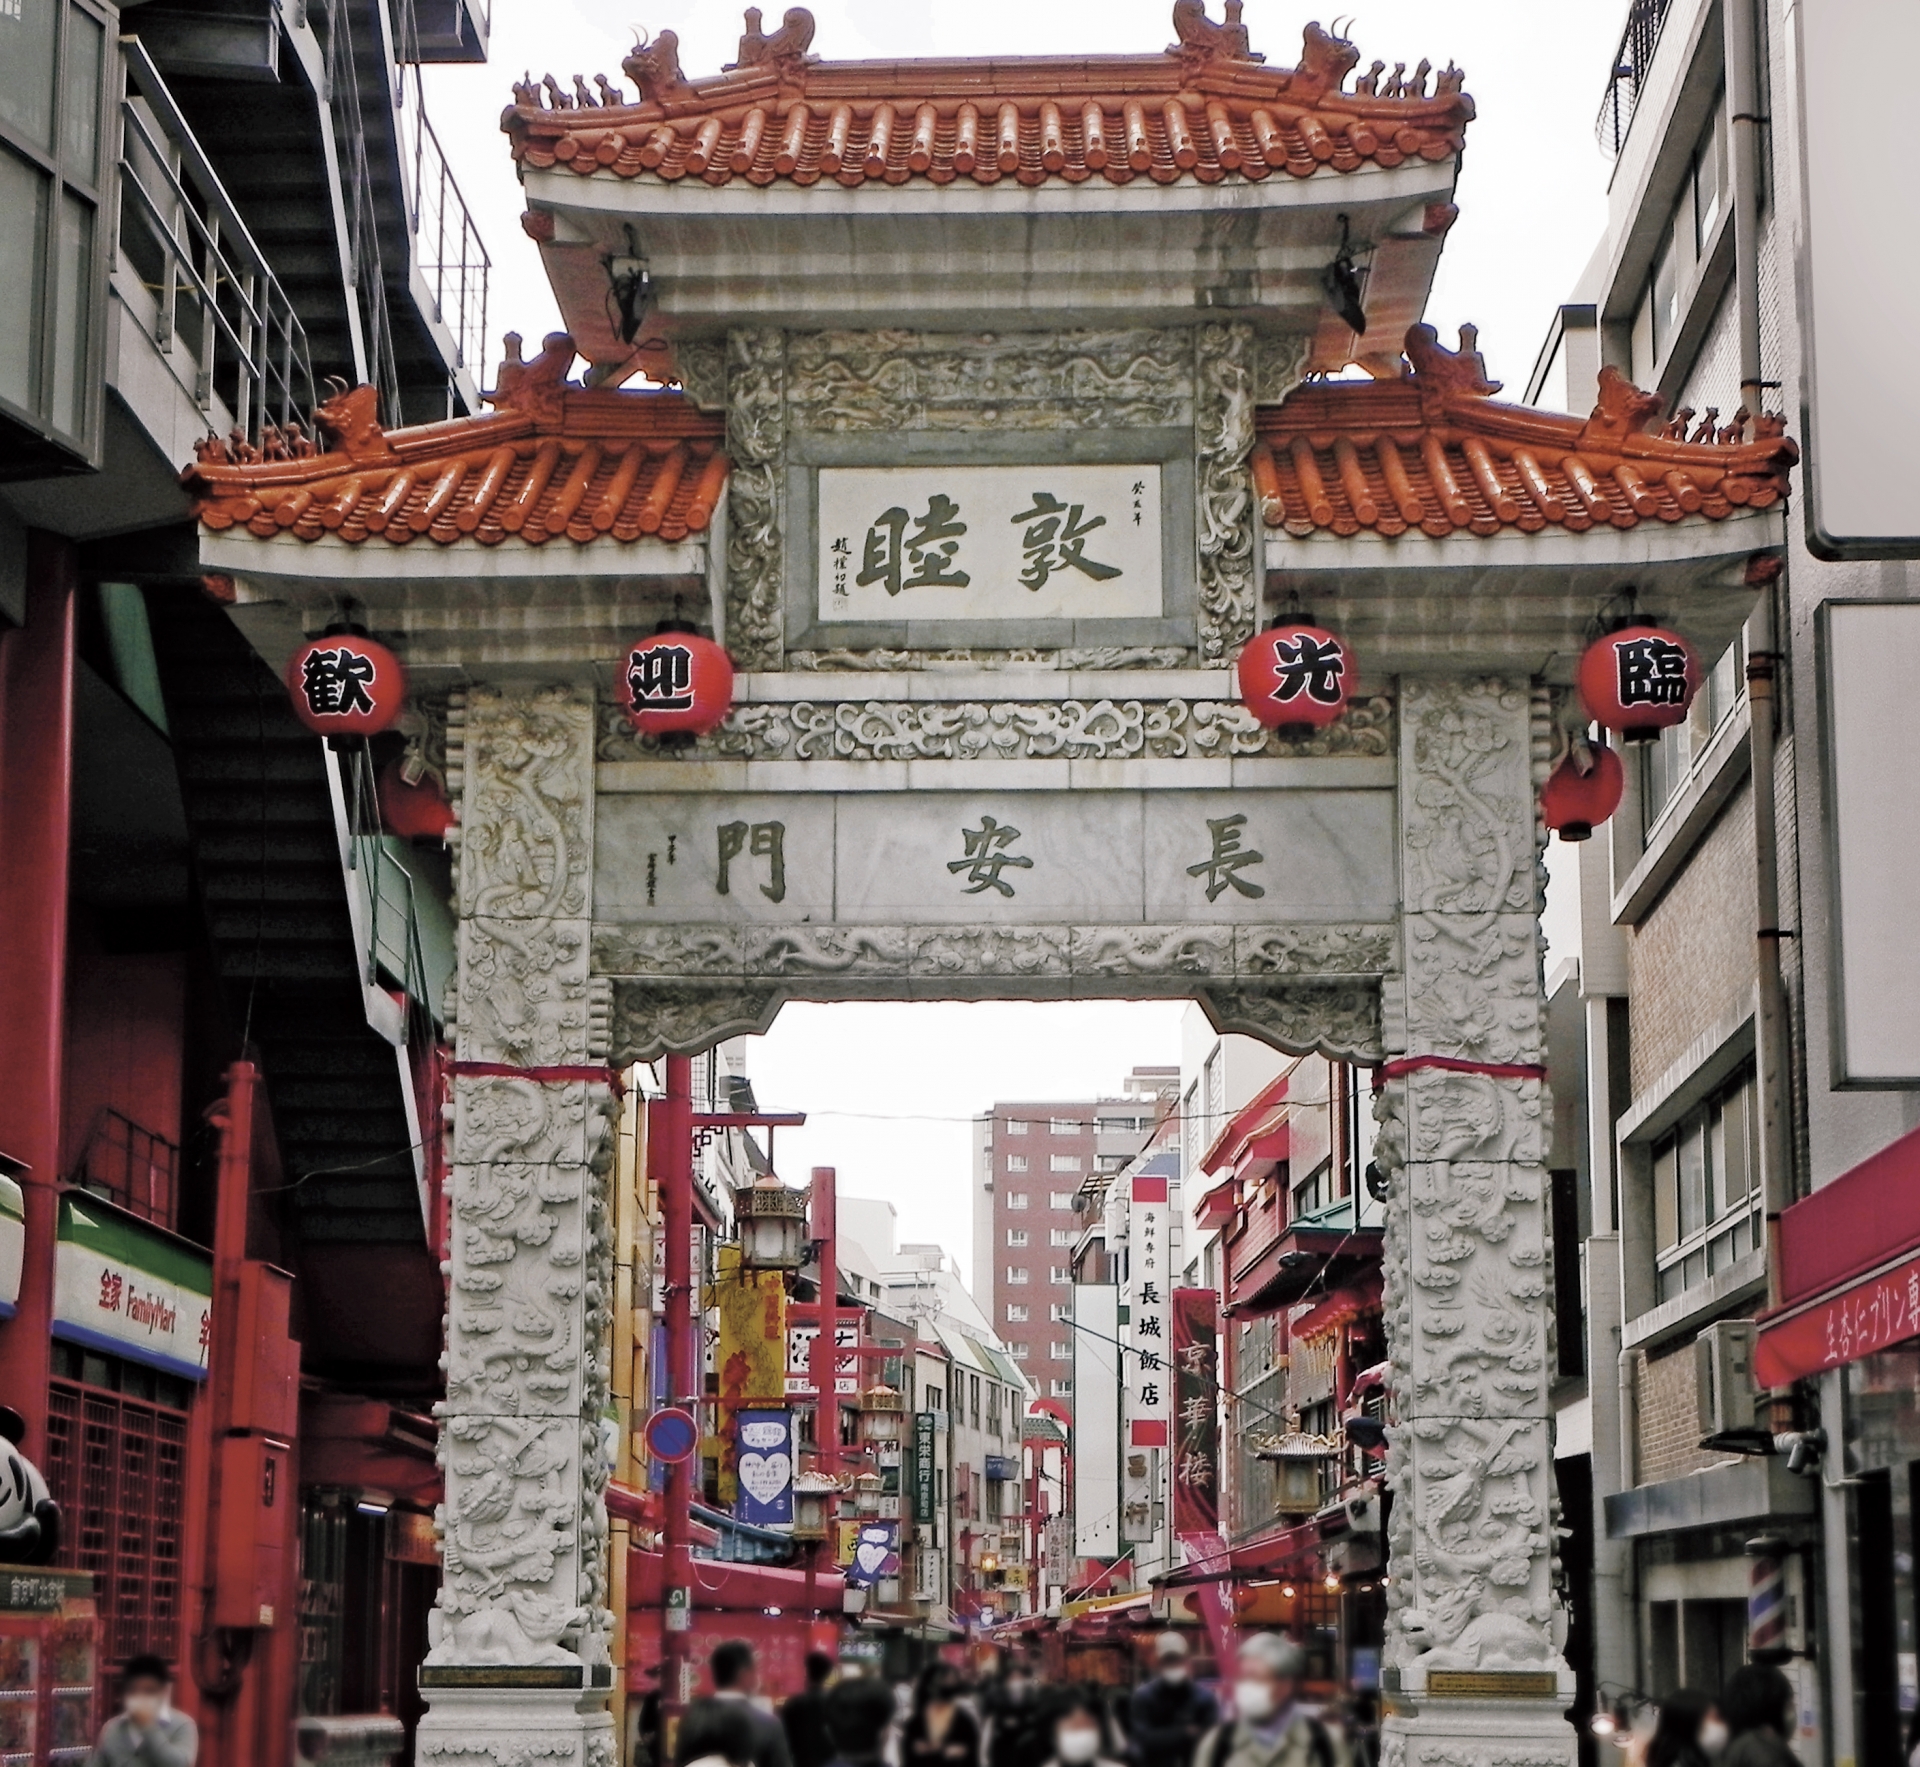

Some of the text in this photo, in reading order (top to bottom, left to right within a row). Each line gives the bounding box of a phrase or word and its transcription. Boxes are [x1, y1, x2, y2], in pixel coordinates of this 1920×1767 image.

[628, 645, 694, 714] 迎
[1270, 633, 1345, 706] 光
[1612, 637, 1688, 708] 臨
[125, 1284, 177, 1335] FamilyMart
[1138, 1281, 1162, 1407] 長城飯店
